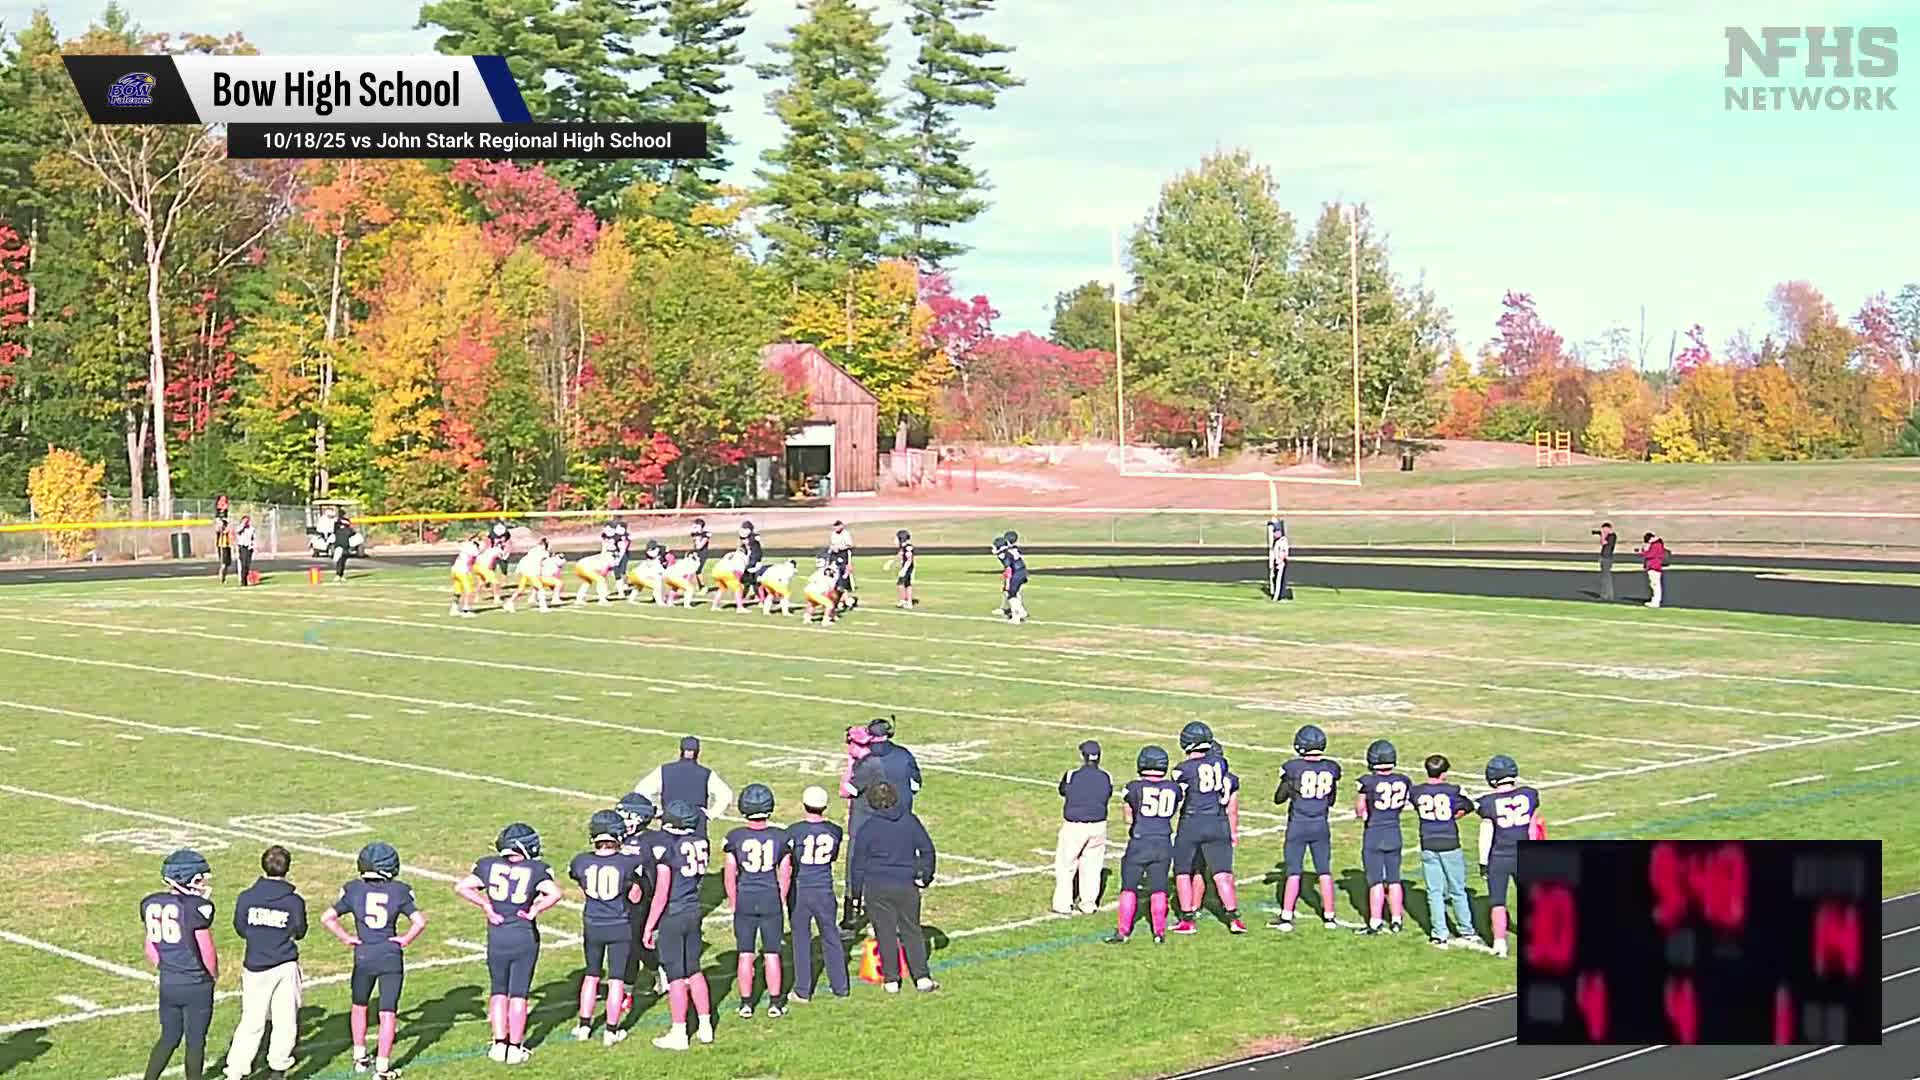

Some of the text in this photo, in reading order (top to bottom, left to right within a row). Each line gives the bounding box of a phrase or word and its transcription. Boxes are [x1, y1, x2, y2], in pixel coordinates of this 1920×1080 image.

[1198, 761, 1223, 793] 81
[1300, 770, 1333, 799] 88
[1140, 786, 1177, 818] 50
[1374, 781, 1407, 811] 32
[1417, 793, 1452, 821] 28
[1494, 794, 1530, 828] 52
[680, 839, 709, 878] 35
[741, 838, 775, 873] 31
[800, 833, 835, 865] 12
[487, 863, 532, 904] 57
[583, 863, 620, 901] 10
[145, 903, 182, 944] 66
[364, 891, 390, 929] 5
